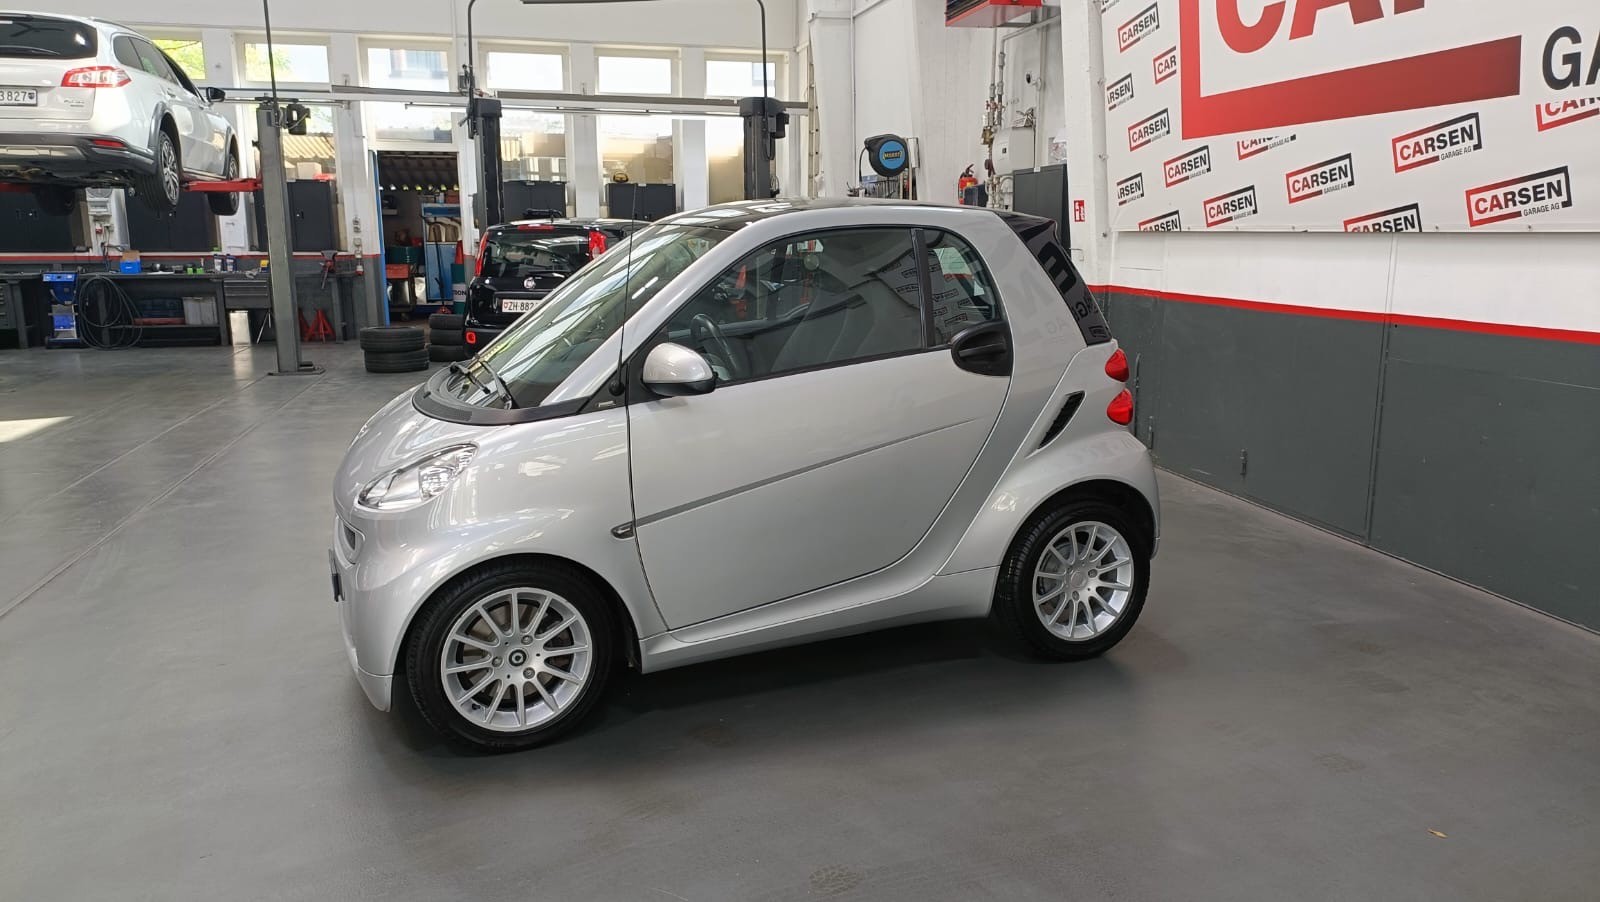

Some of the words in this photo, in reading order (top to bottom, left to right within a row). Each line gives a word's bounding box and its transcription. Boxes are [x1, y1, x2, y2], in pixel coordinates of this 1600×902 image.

[1121, 11, 1156, 43] CARSEN
[1107, 82, 1130, 104] RSEN
[1132, 116, 1167, 143] CARSEN
[1400, 124, 1474, 161] CARSEN
[1440, 149, 1462, 160] GARAGE
[1463, 145, 1472, 153] AG
[1168, 153, 1207, 179] CARSEN
[1292, 164, 1349, 193] CARSEN
[1117, 180, 1141, 199] RSEN
[1475, 179, 1563, 214] CARSEN
[1208, 194, 1253, 218] CARSEN
[1523, 205, 1550, 217] GARAGE
[1550, 202, 1560, 211] AG
